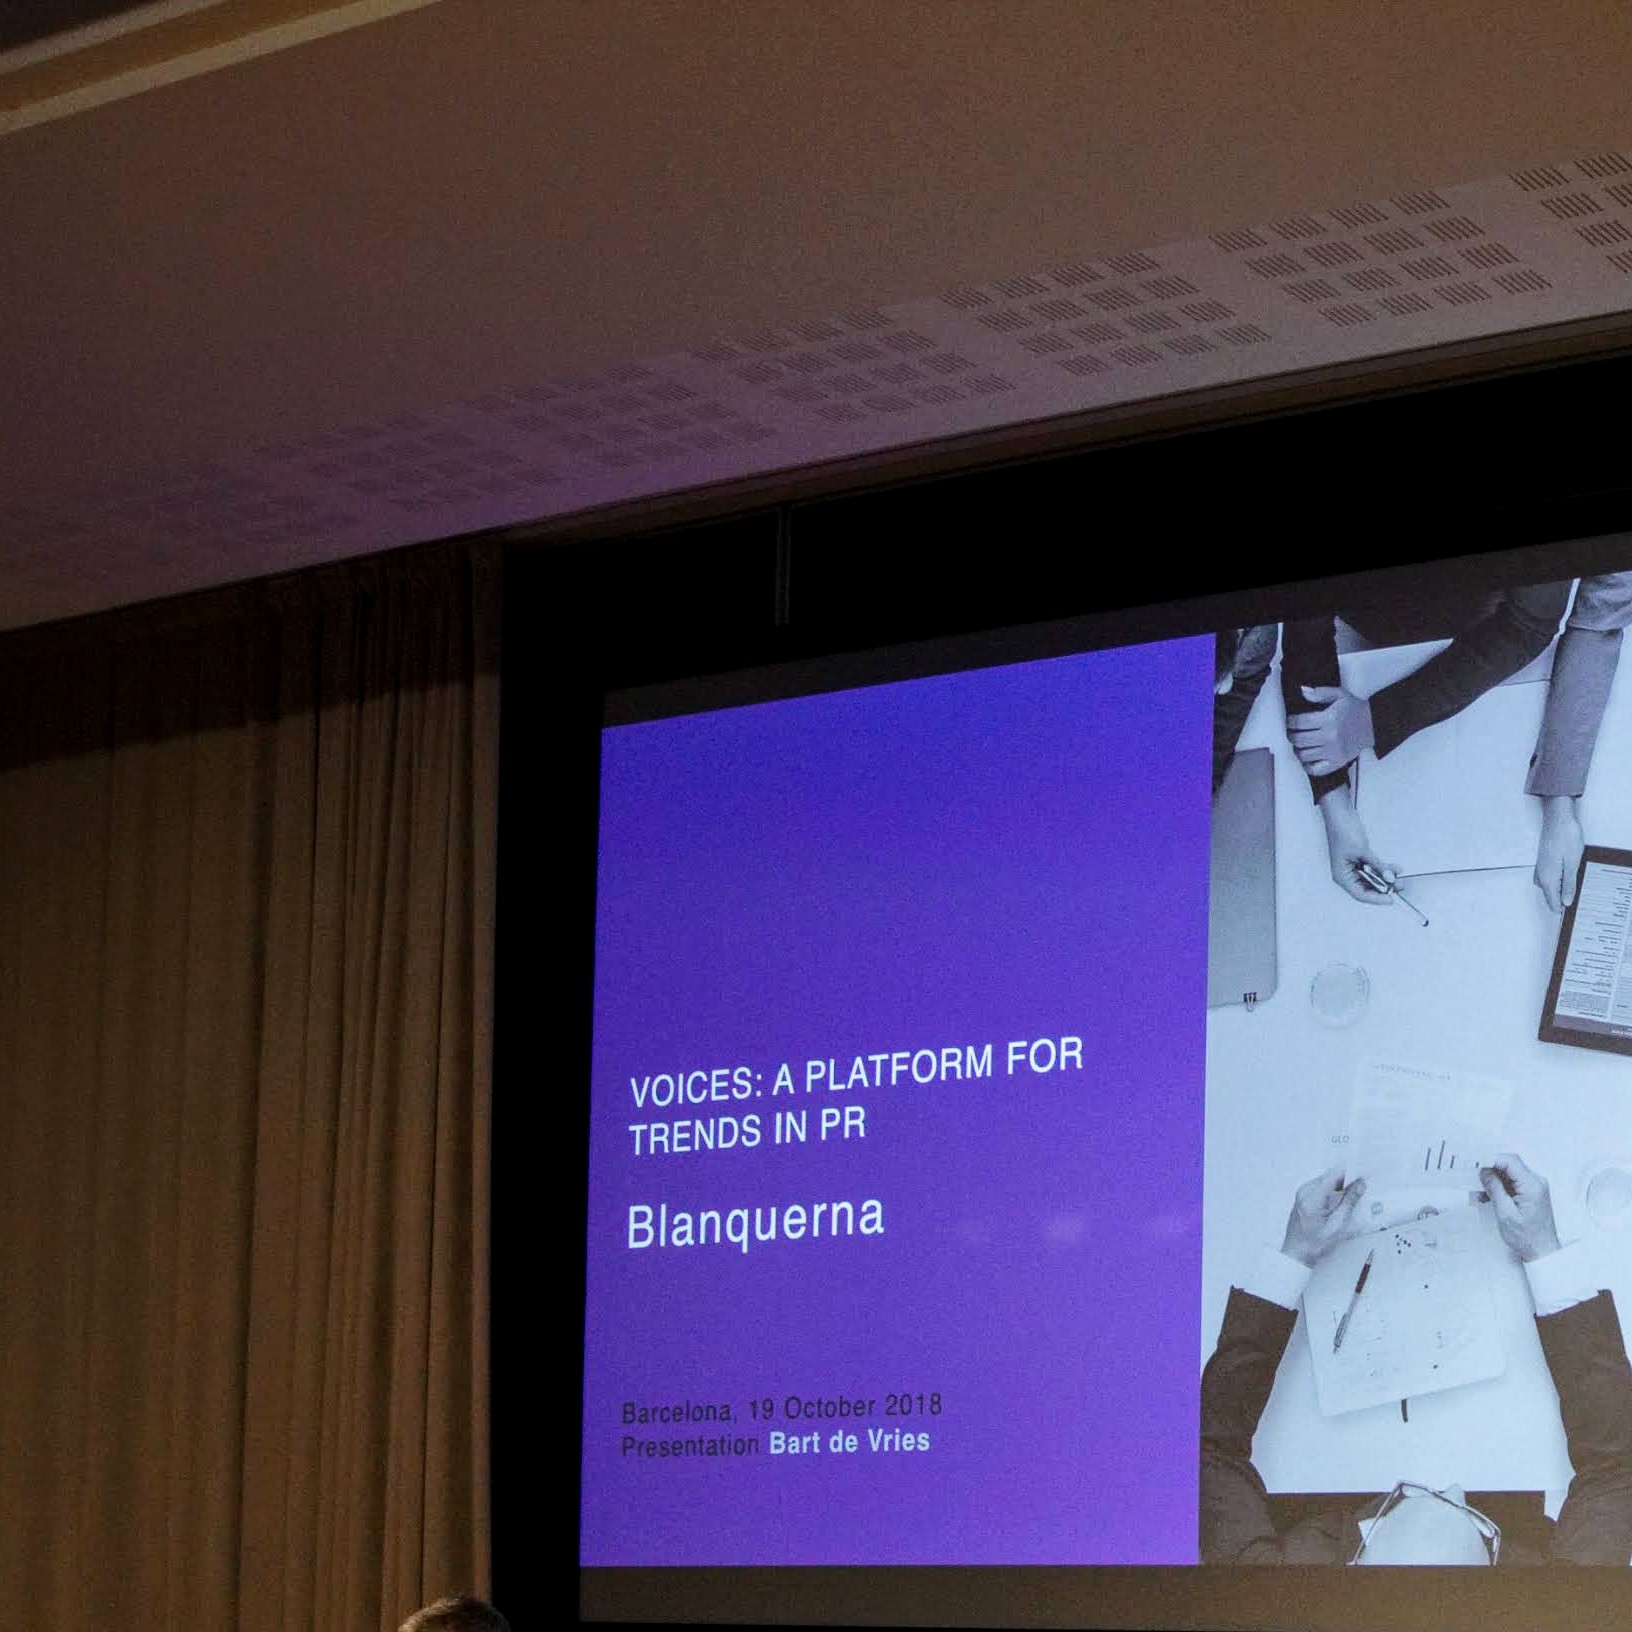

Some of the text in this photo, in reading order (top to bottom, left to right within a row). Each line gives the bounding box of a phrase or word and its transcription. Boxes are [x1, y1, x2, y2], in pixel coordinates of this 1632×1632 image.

[630, 1036, 1084, 1109] VOICES: A PLATFORM FOR
[629, 1106, 867, 1156] TRENDS IN PR
[628, 1199, 886, 1254] Blanquerna
[621, 1392, 943, 1425] Barcelona, 19 October 2018
[621, 1428, 931, 1457] Presentation Bart de Vries
